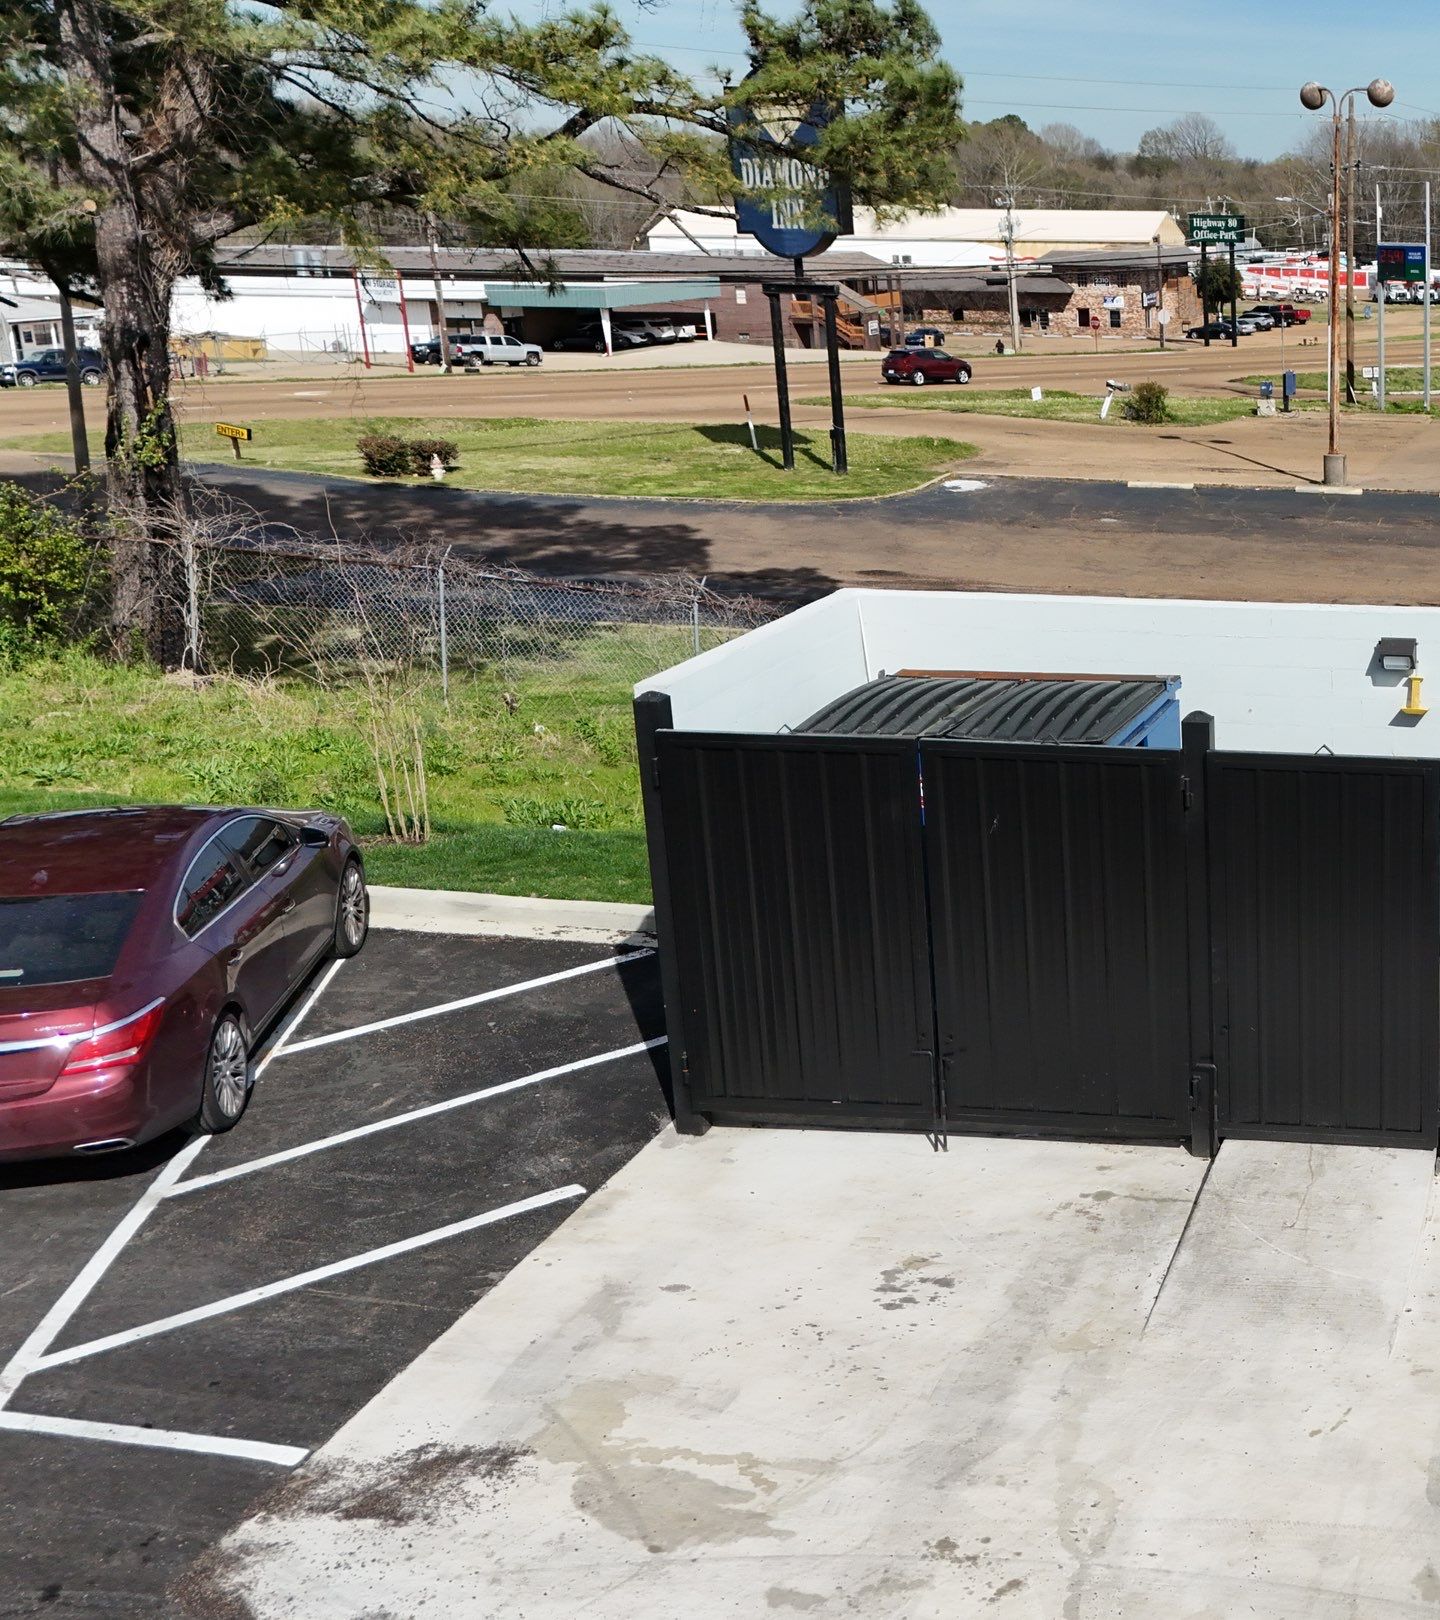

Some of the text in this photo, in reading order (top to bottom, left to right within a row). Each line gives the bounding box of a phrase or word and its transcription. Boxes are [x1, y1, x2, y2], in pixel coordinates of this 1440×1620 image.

[1193, 218, 1238, 229] Highway 80
[1193, 230, 1238, 240] Office Park
[216, 425, 240, 437] ENTER
